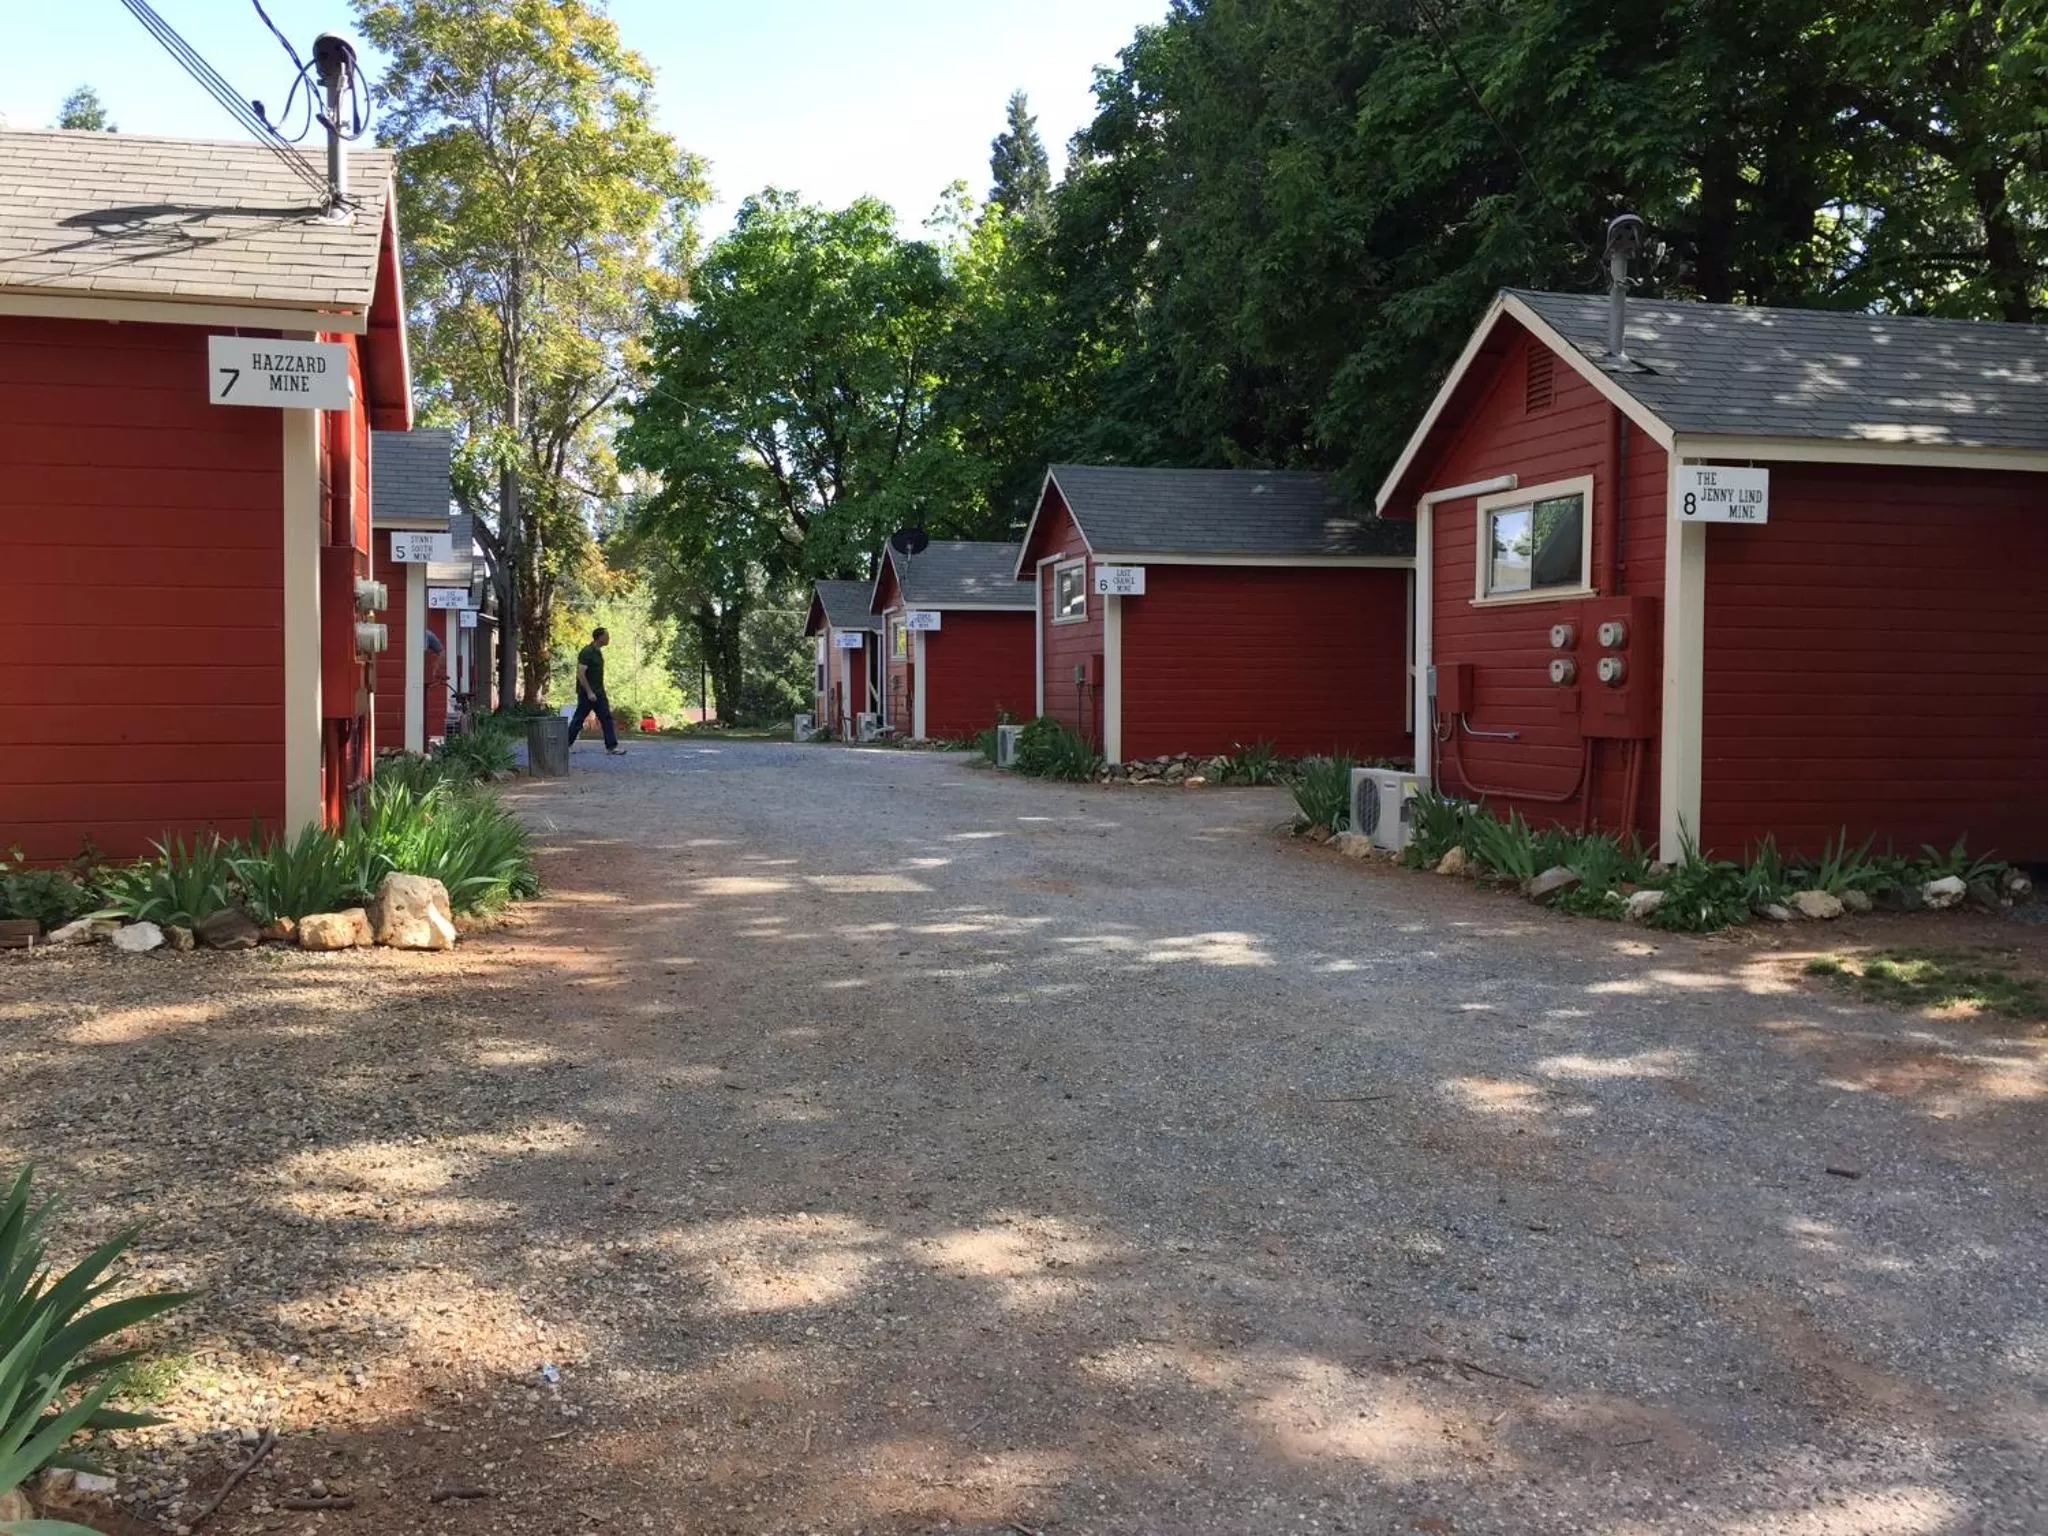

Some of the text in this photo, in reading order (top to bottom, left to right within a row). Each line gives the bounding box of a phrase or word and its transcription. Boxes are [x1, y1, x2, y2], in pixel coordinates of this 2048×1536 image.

[252, 353, 326, 373] HAZZARD
[219, 368, 240, 397] 7
[269, 374, 310, 392] MINE
[1697, 472, 1717, 485] THE
[1701, 488, 1763, 503] JENNY LIND
[1684, 492, 1696, 515] 8
[1728, 505, 1756, 518] MINE
[396, 545, 406, 559] 5
[1100, 580, 1108, 591] 6
[431, 597, 438, 606] 3
